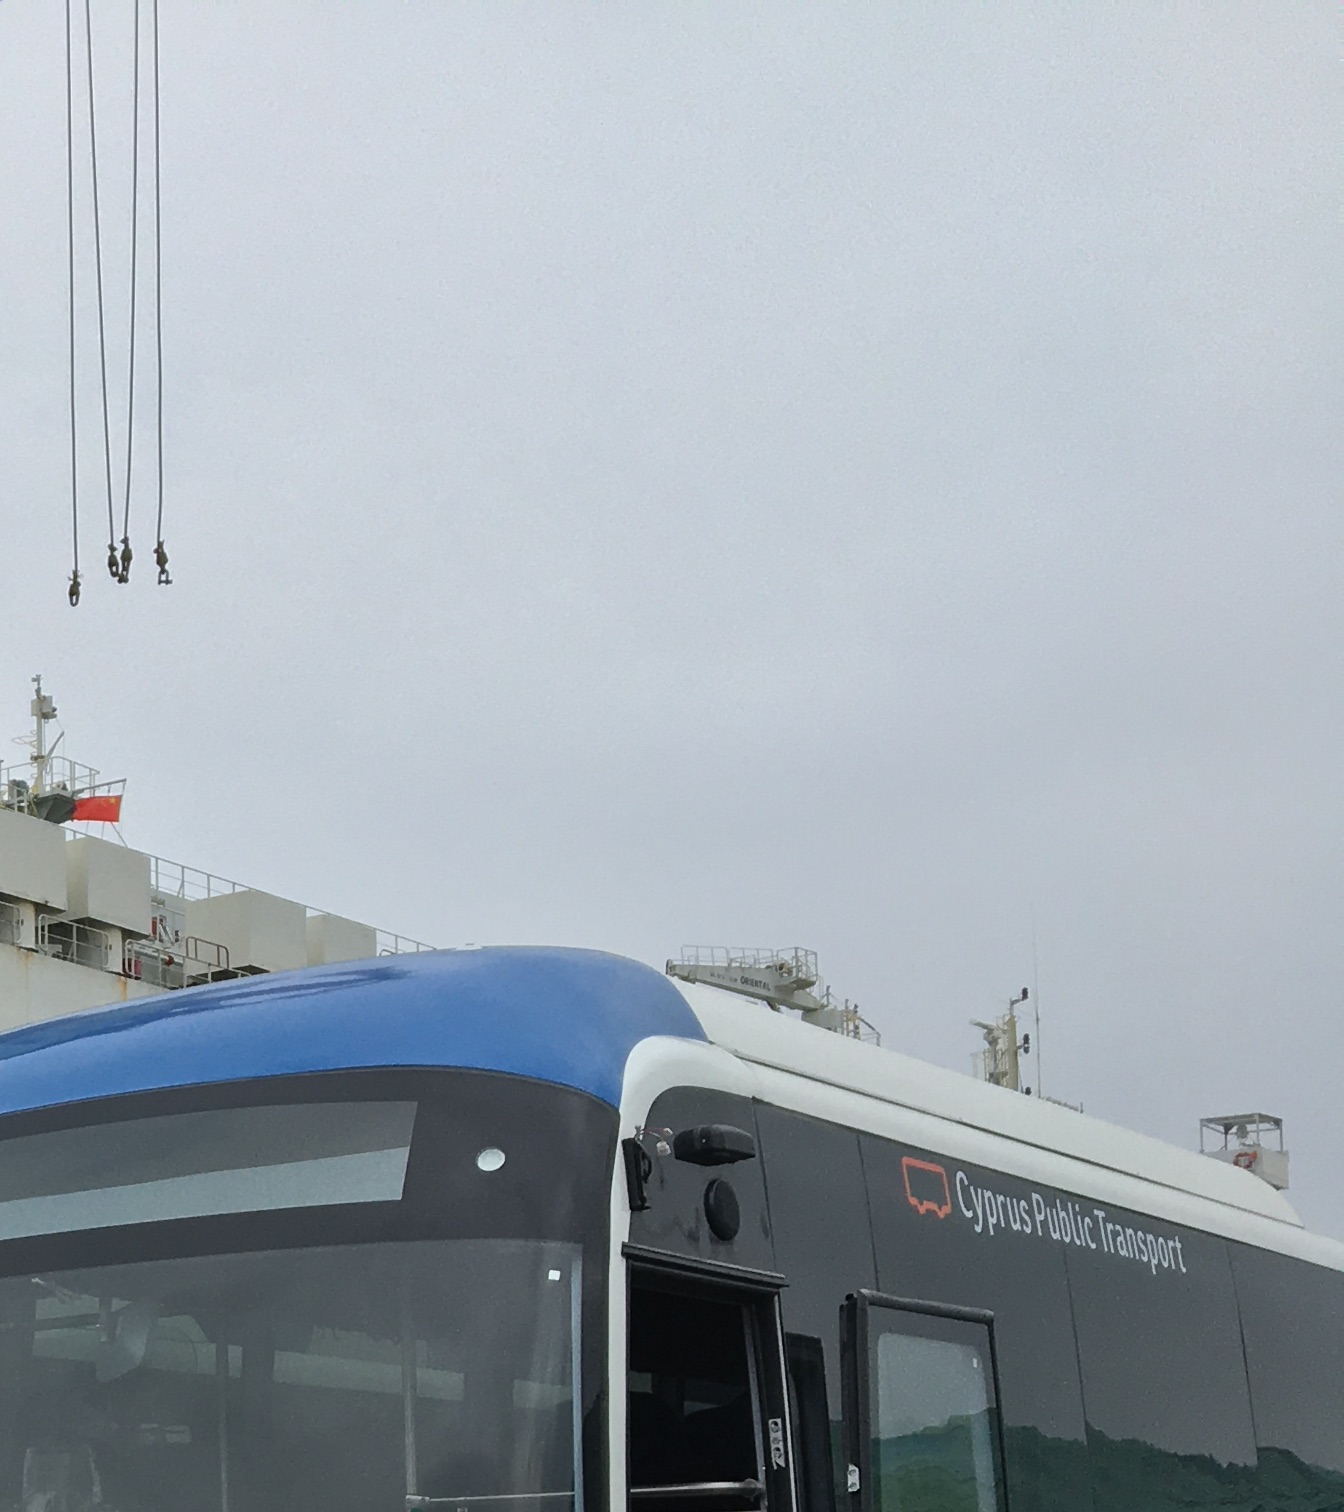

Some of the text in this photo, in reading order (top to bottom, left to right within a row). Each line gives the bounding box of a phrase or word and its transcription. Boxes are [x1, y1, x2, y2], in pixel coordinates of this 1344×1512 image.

[955, 1169, 1187, 1276] Cyprus Public Transport
